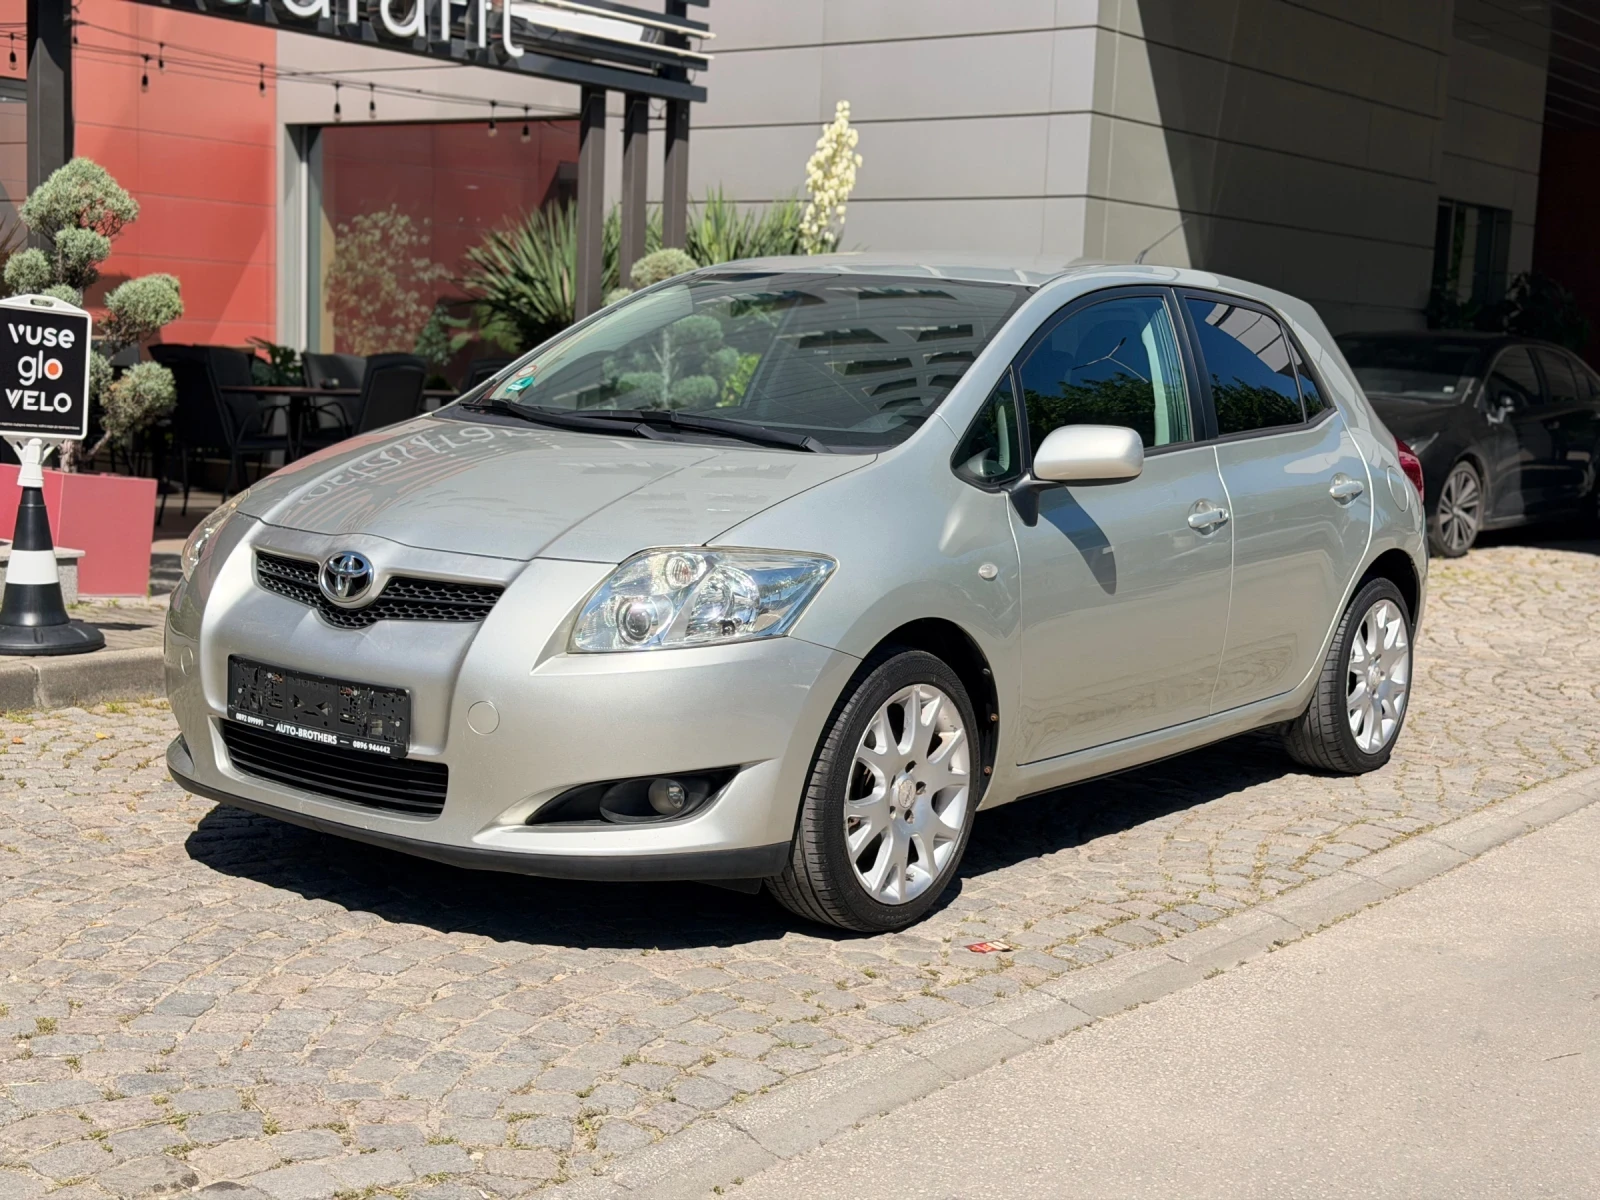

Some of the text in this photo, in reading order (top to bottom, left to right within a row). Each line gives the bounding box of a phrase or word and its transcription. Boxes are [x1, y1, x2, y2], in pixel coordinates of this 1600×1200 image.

[7, 323, 75, 349] vuse
[17, 350, 63, 386] glo
[5, 388, 72, 413] VELO
[275, 722, 338, 745] AUTO-BROTHERS
